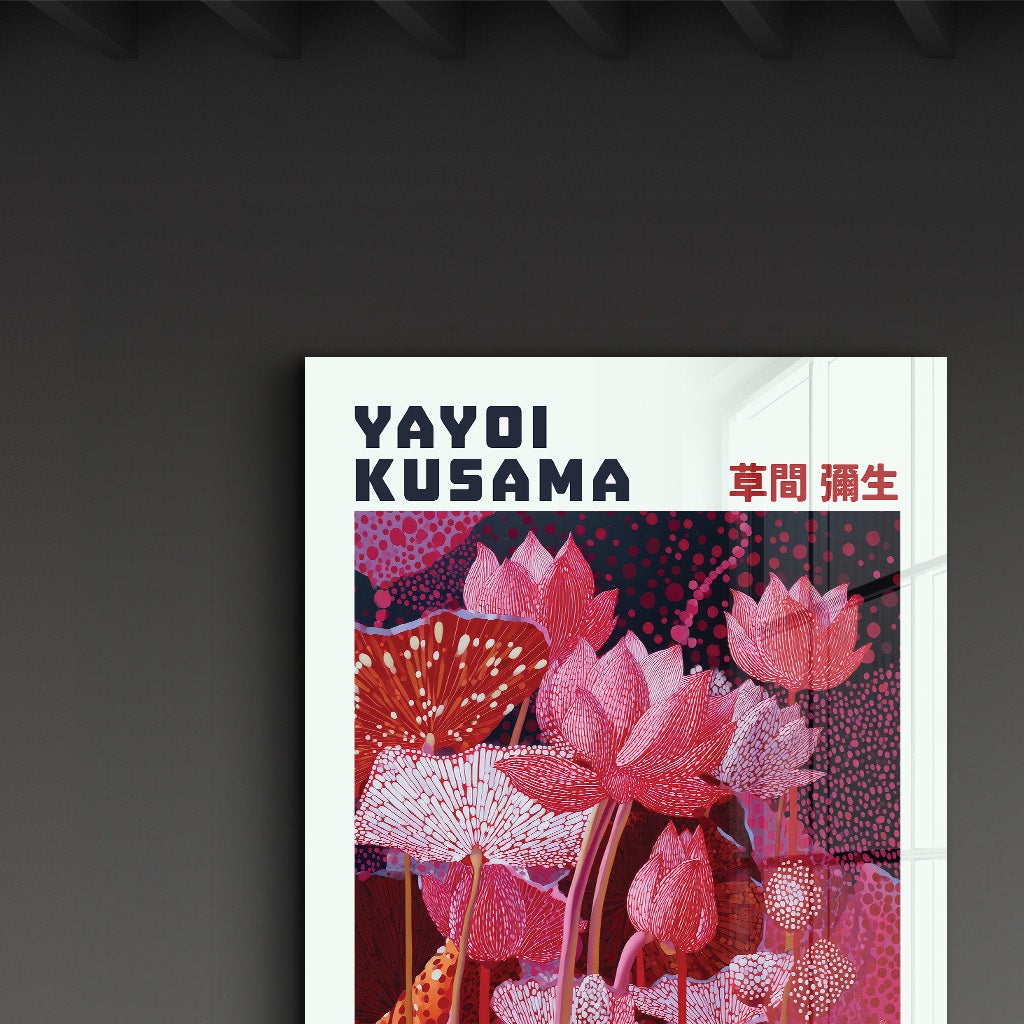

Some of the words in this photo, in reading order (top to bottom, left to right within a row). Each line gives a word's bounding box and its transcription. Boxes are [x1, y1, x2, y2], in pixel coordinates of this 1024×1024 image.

[354, 405, 548, 449] YAYOI
[354, 458, 630, 502] KUSAMA
[729, 462, 807, 503] 草間
